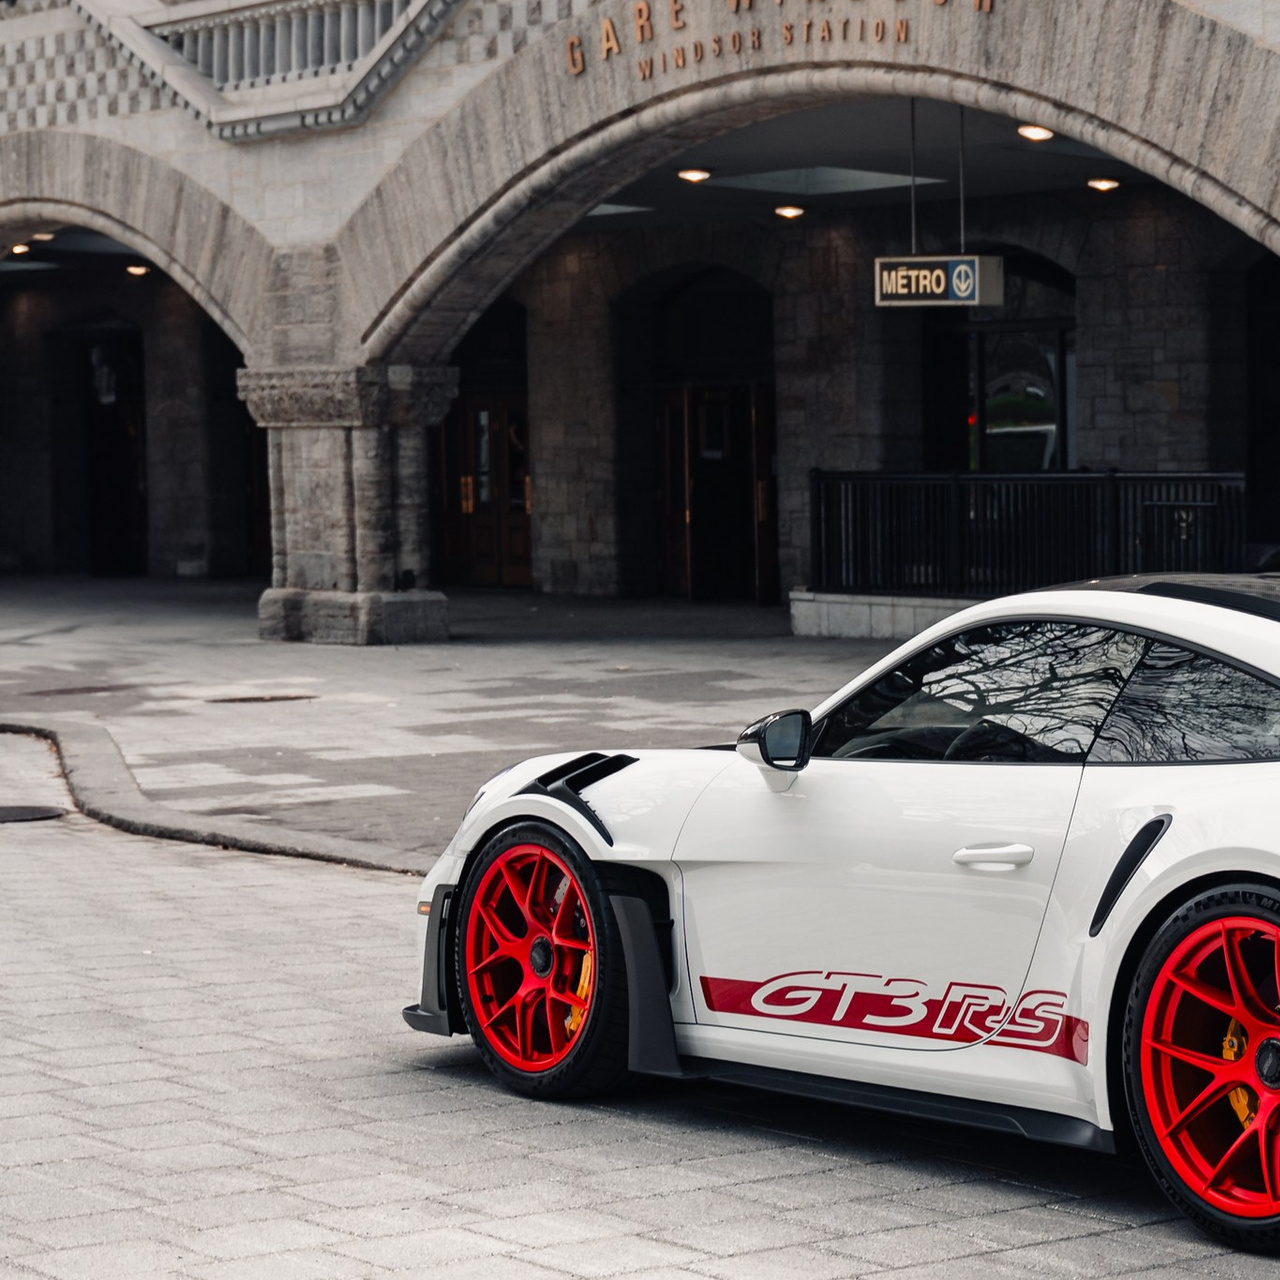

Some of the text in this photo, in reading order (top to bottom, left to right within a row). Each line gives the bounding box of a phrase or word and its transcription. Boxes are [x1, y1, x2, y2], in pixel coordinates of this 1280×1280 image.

[637, 18, 909, 80] WINDSOR STATION
[882, 266, 947, 295] MÉTRO
